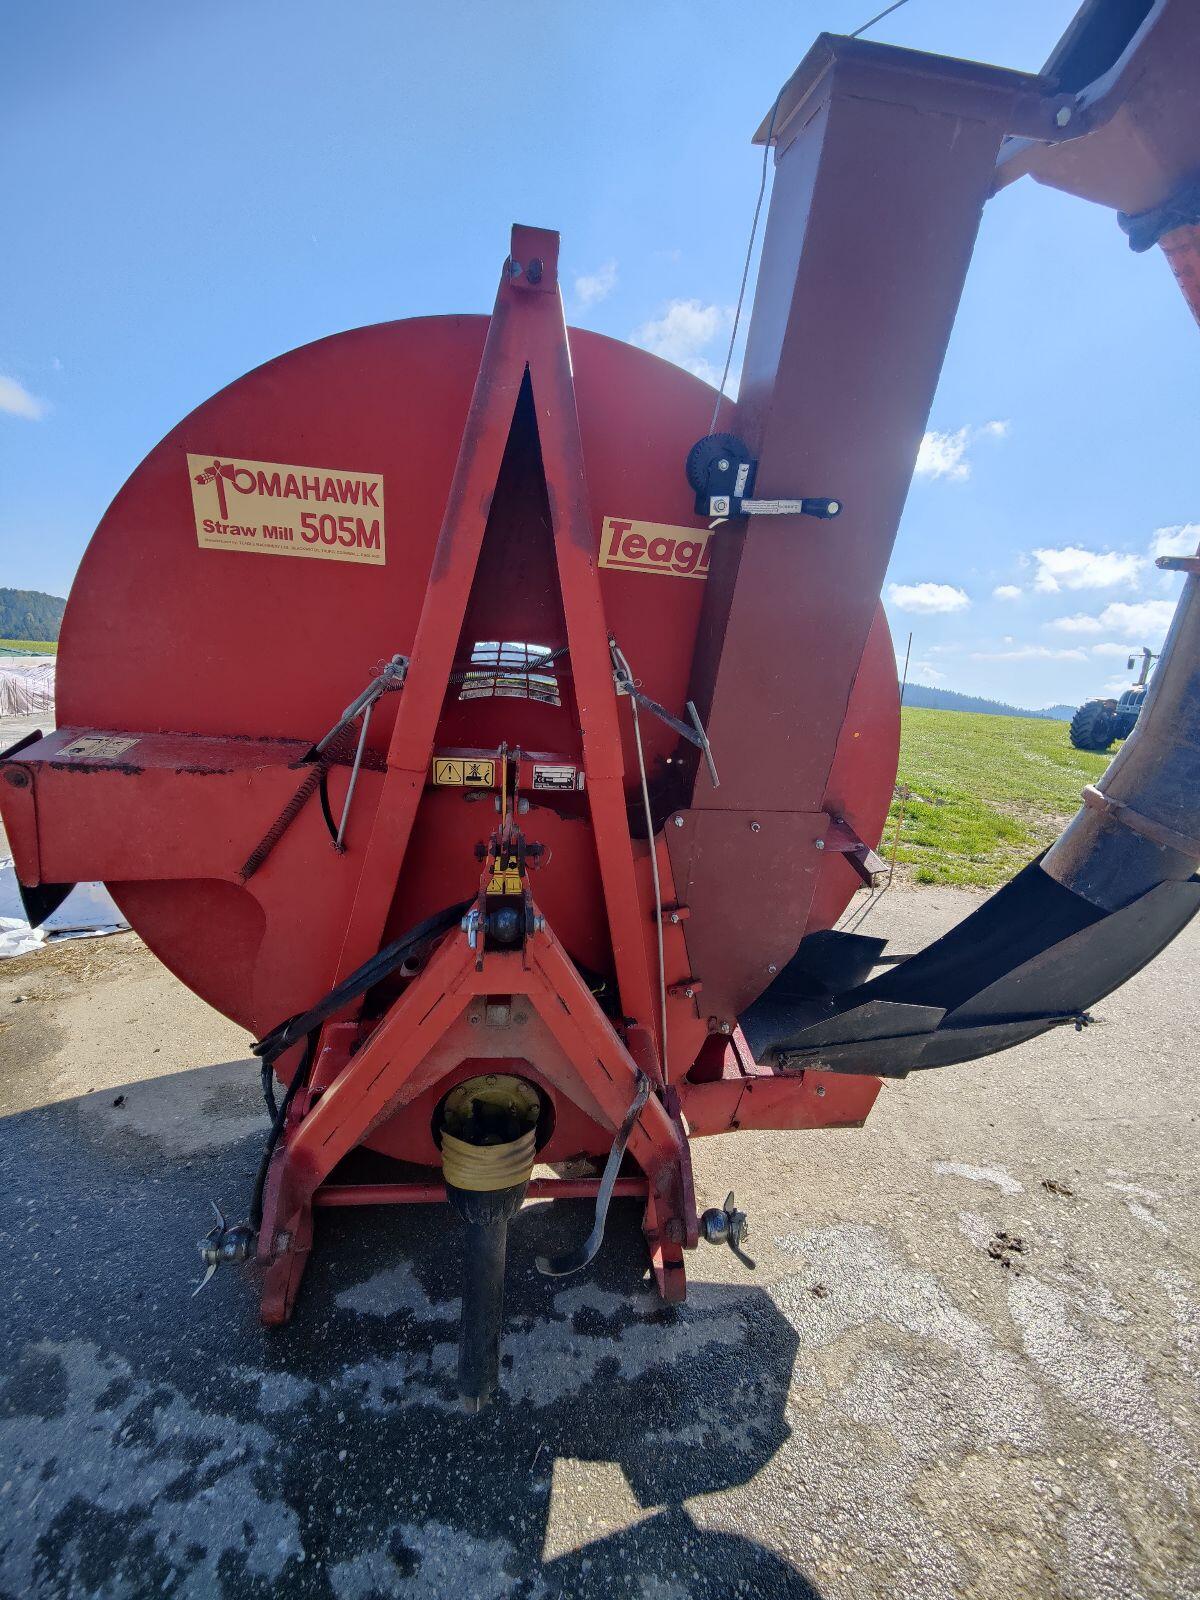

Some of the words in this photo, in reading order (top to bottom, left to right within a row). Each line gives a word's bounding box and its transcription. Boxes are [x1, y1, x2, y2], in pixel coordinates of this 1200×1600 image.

[202, 519, 257, 538] Straw
[262, 524, 294, 541] Mill
[300, 511, 381, 550] 505M
